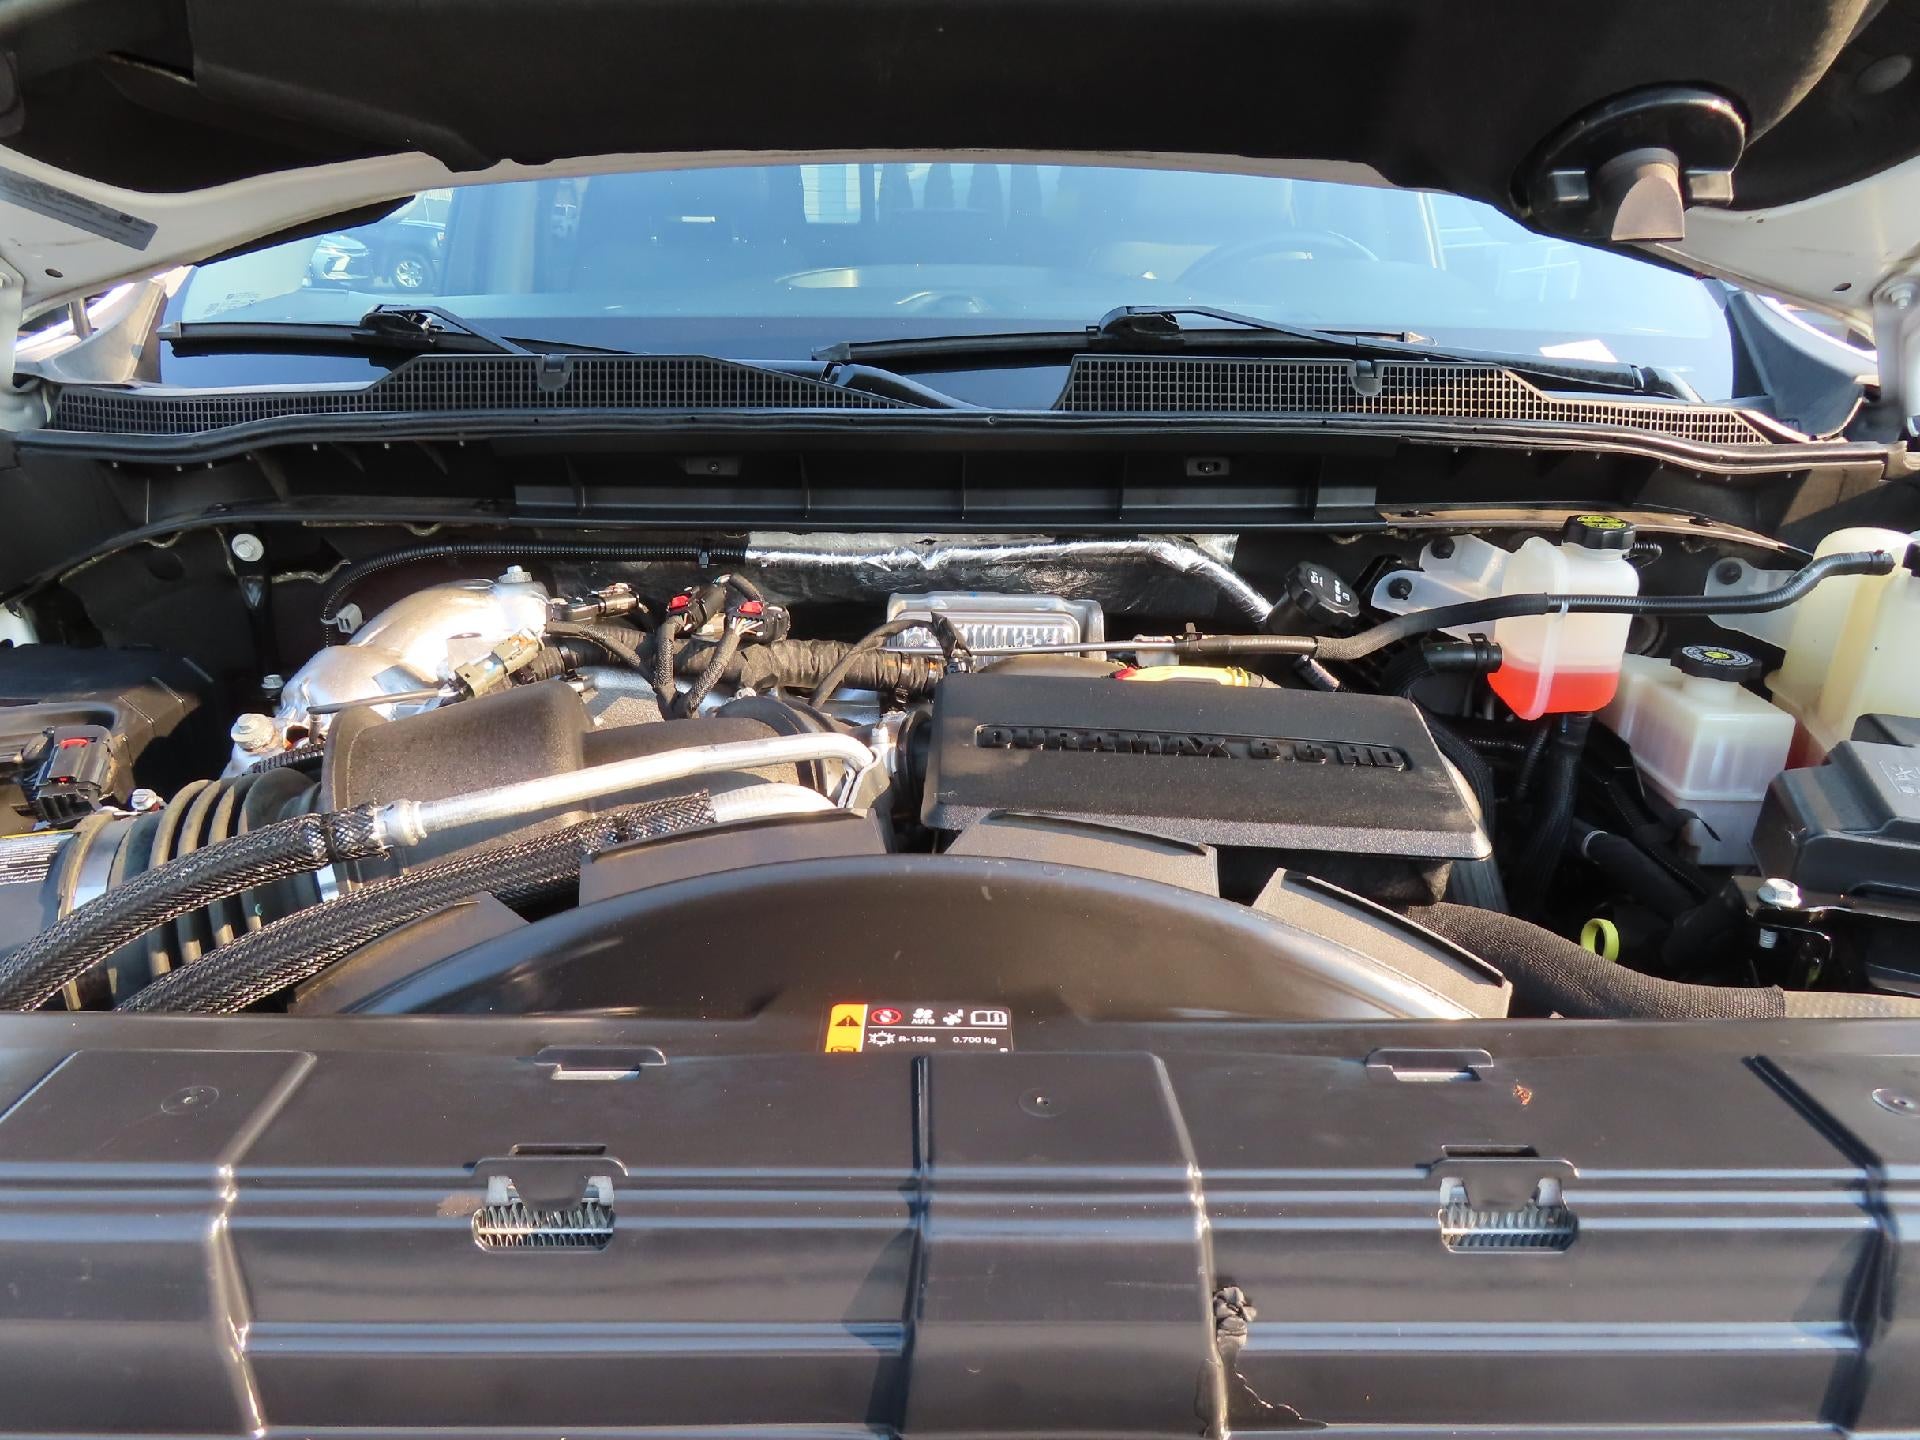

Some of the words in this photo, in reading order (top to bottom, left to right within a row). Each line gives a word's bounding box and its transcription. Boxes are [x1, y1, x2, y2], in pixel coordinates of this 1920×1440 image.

[977, 726, 1232, 759] DURAMAX
[1248, 737, 1328, 764] 6.6
[1333, 742, 1404, 770] HD
[898, 1035, 936, 1043] R-134a
[952, 1035, 981, 1043] 0.700
[983, 1035, 997, 1045] kg
